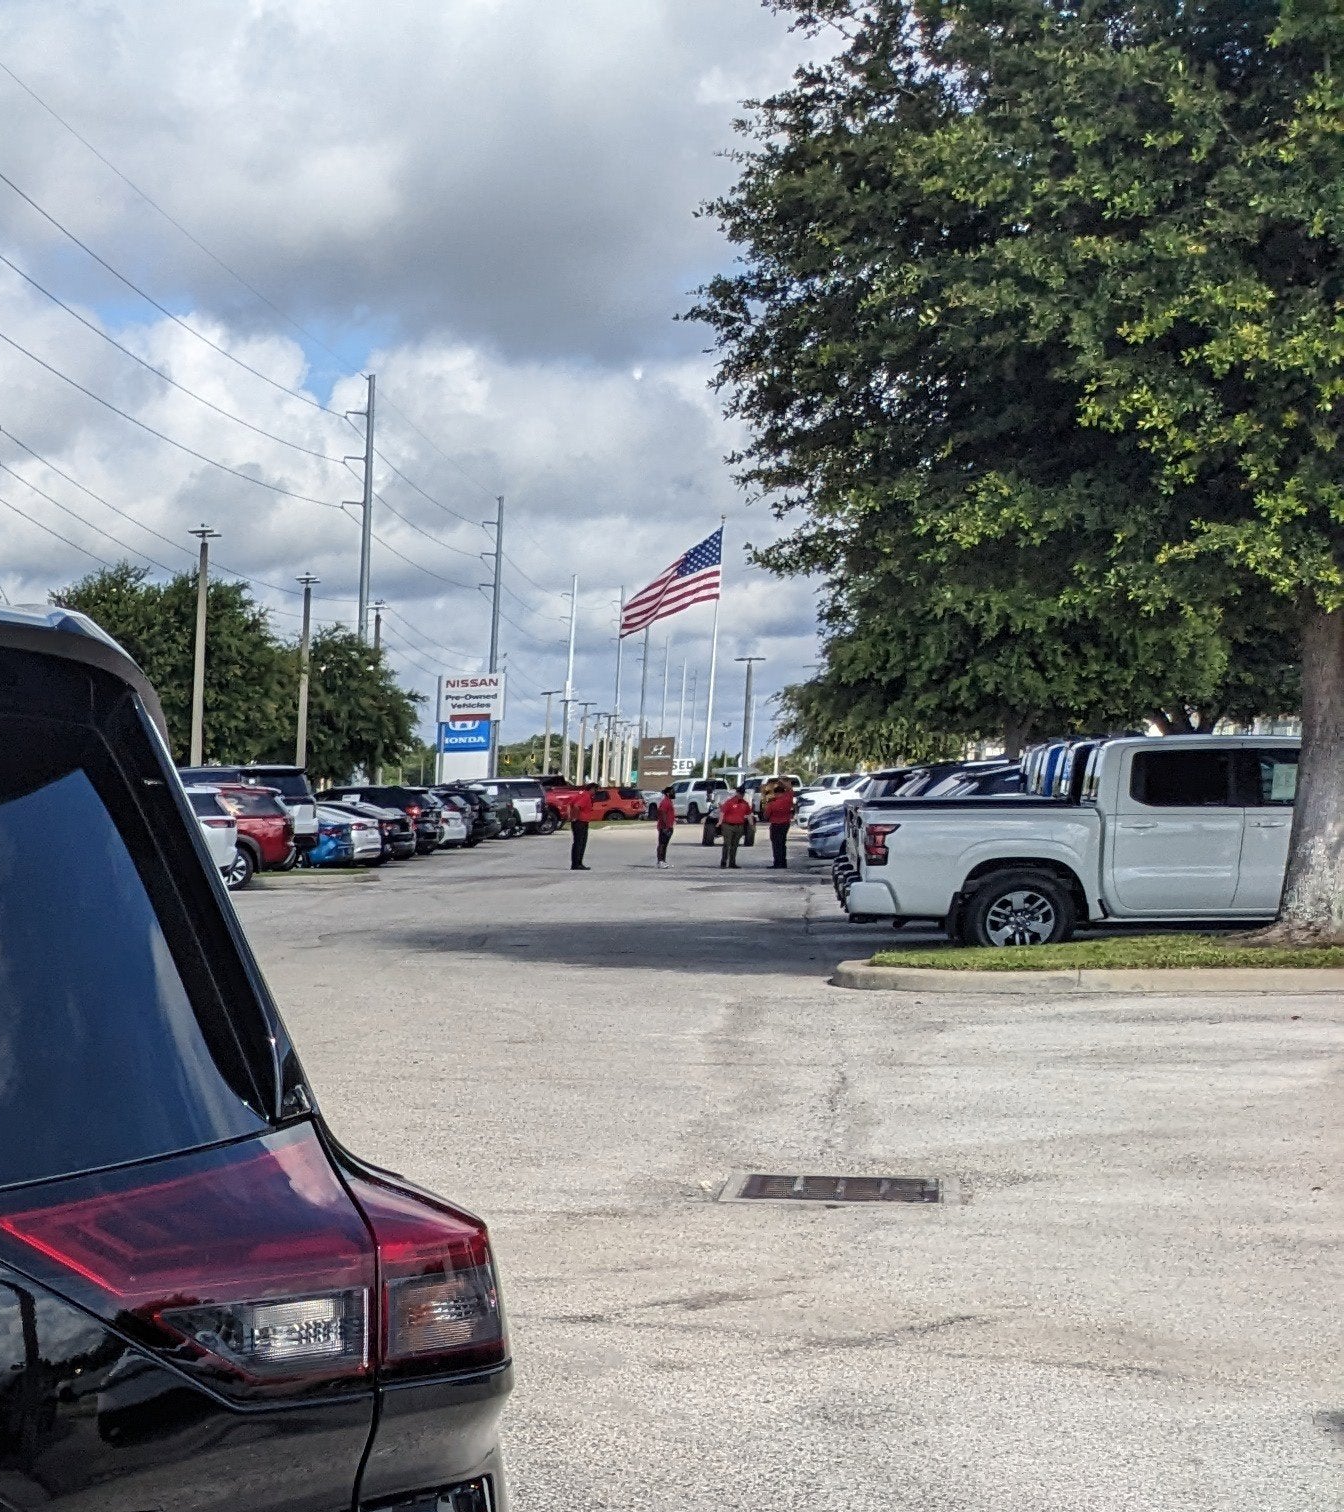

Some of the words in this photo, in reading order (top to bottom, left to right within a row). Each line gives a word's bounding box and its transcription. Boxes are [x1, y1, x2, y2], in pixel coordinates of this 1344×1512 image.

[445, 678, 499, 688] NISSAN
[445, 693, 498, 701] Pre-Owned
[672, 760, 693, 770] SED
